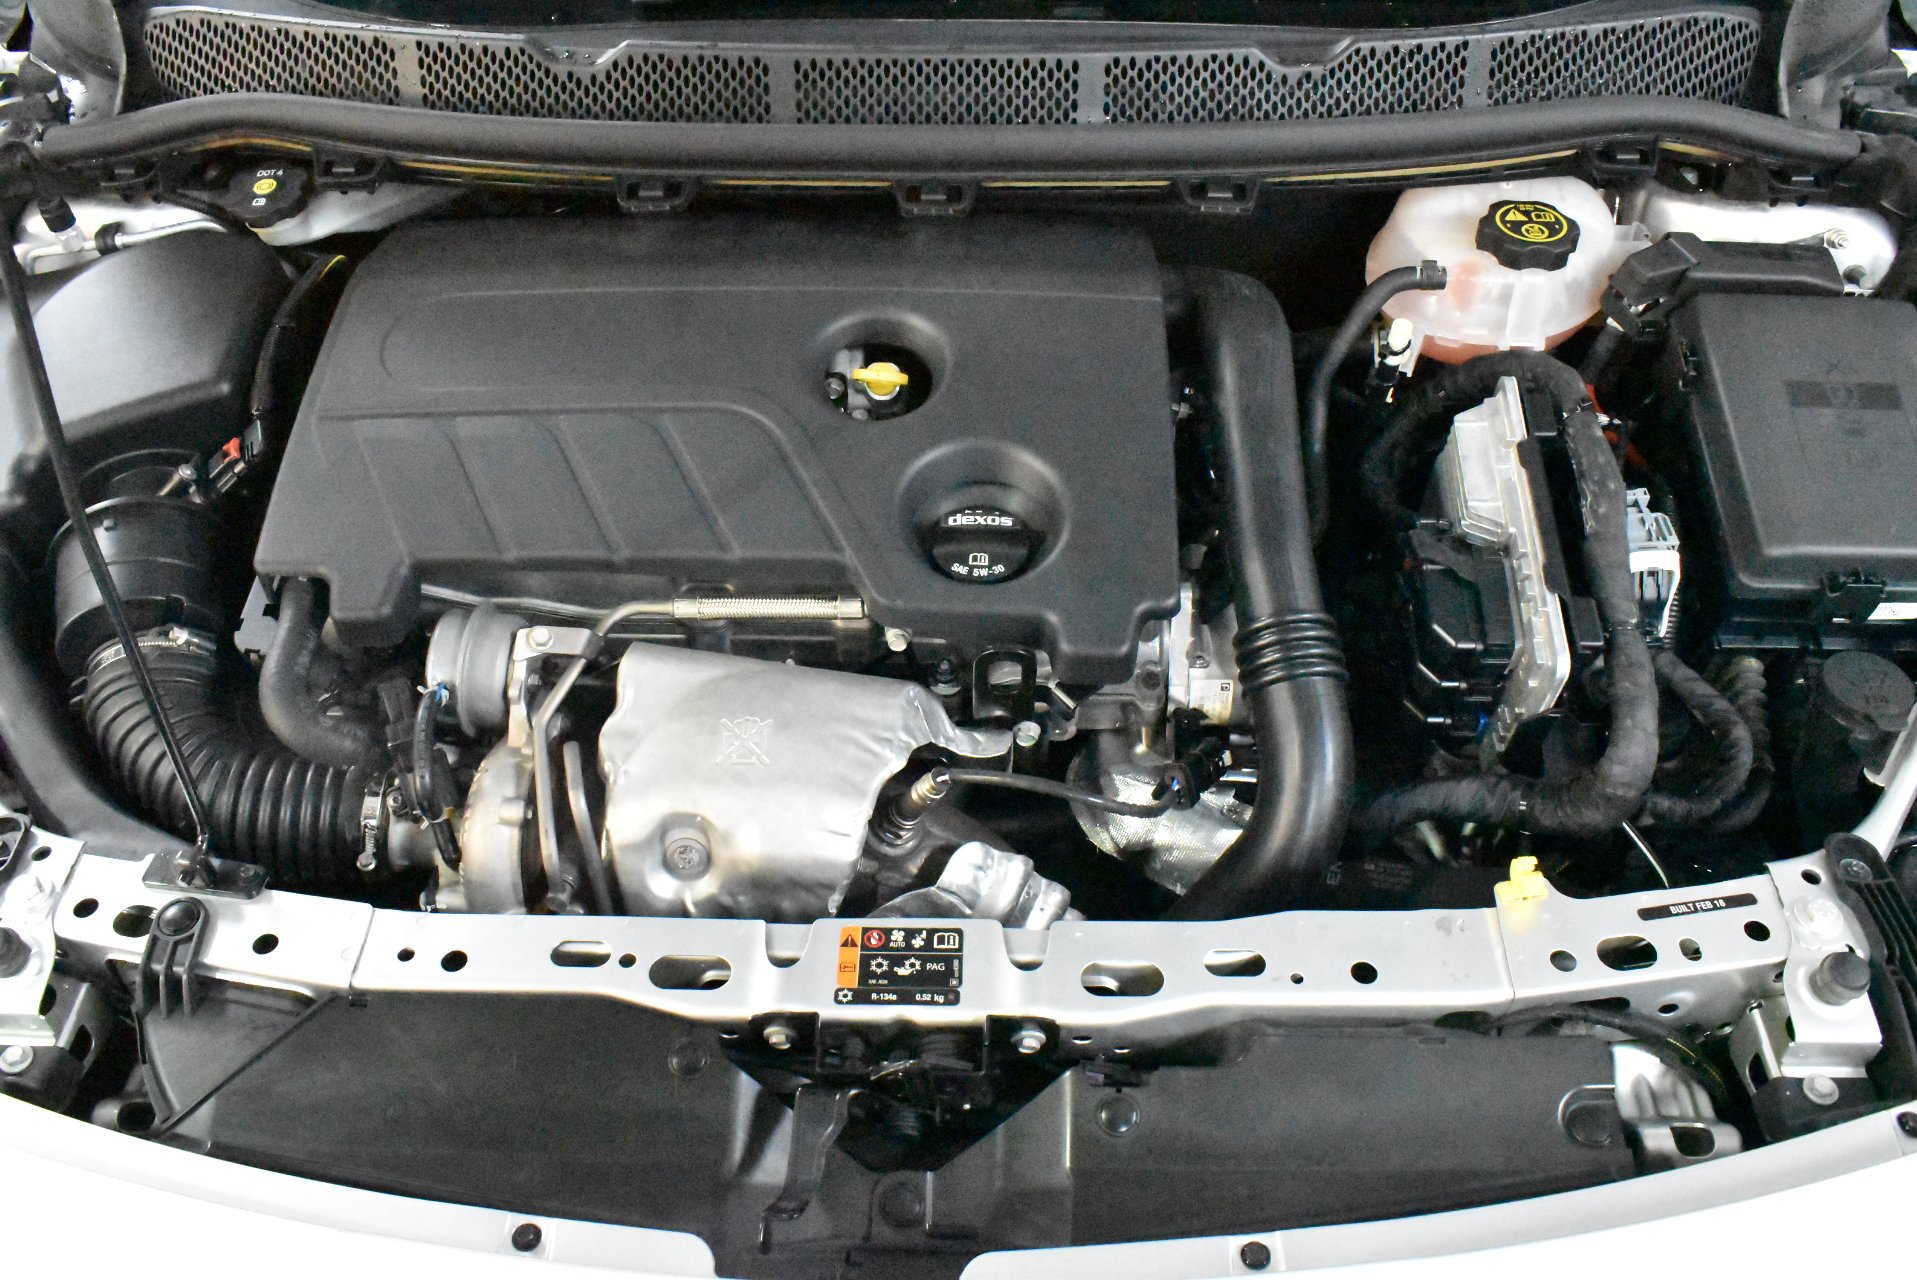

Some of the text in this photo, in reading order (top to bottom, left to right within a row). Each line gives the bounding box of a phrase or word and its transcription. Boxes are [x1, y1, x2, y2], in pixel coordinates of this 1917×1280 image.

[257, 168, 284, 177] DOT 4
[948, 513, 1014, 527] dexos
[951, 562, 1005, 577] SAE 5W-30
[1669, 898, 1726, 915] BUILT FEB 18
[926, 962, 946, 971] PAG
[871, 992, 897, 1001] R-134a
[915, 993, 932, 1001] 0.52
[933, 992, 945, 1003] kg
